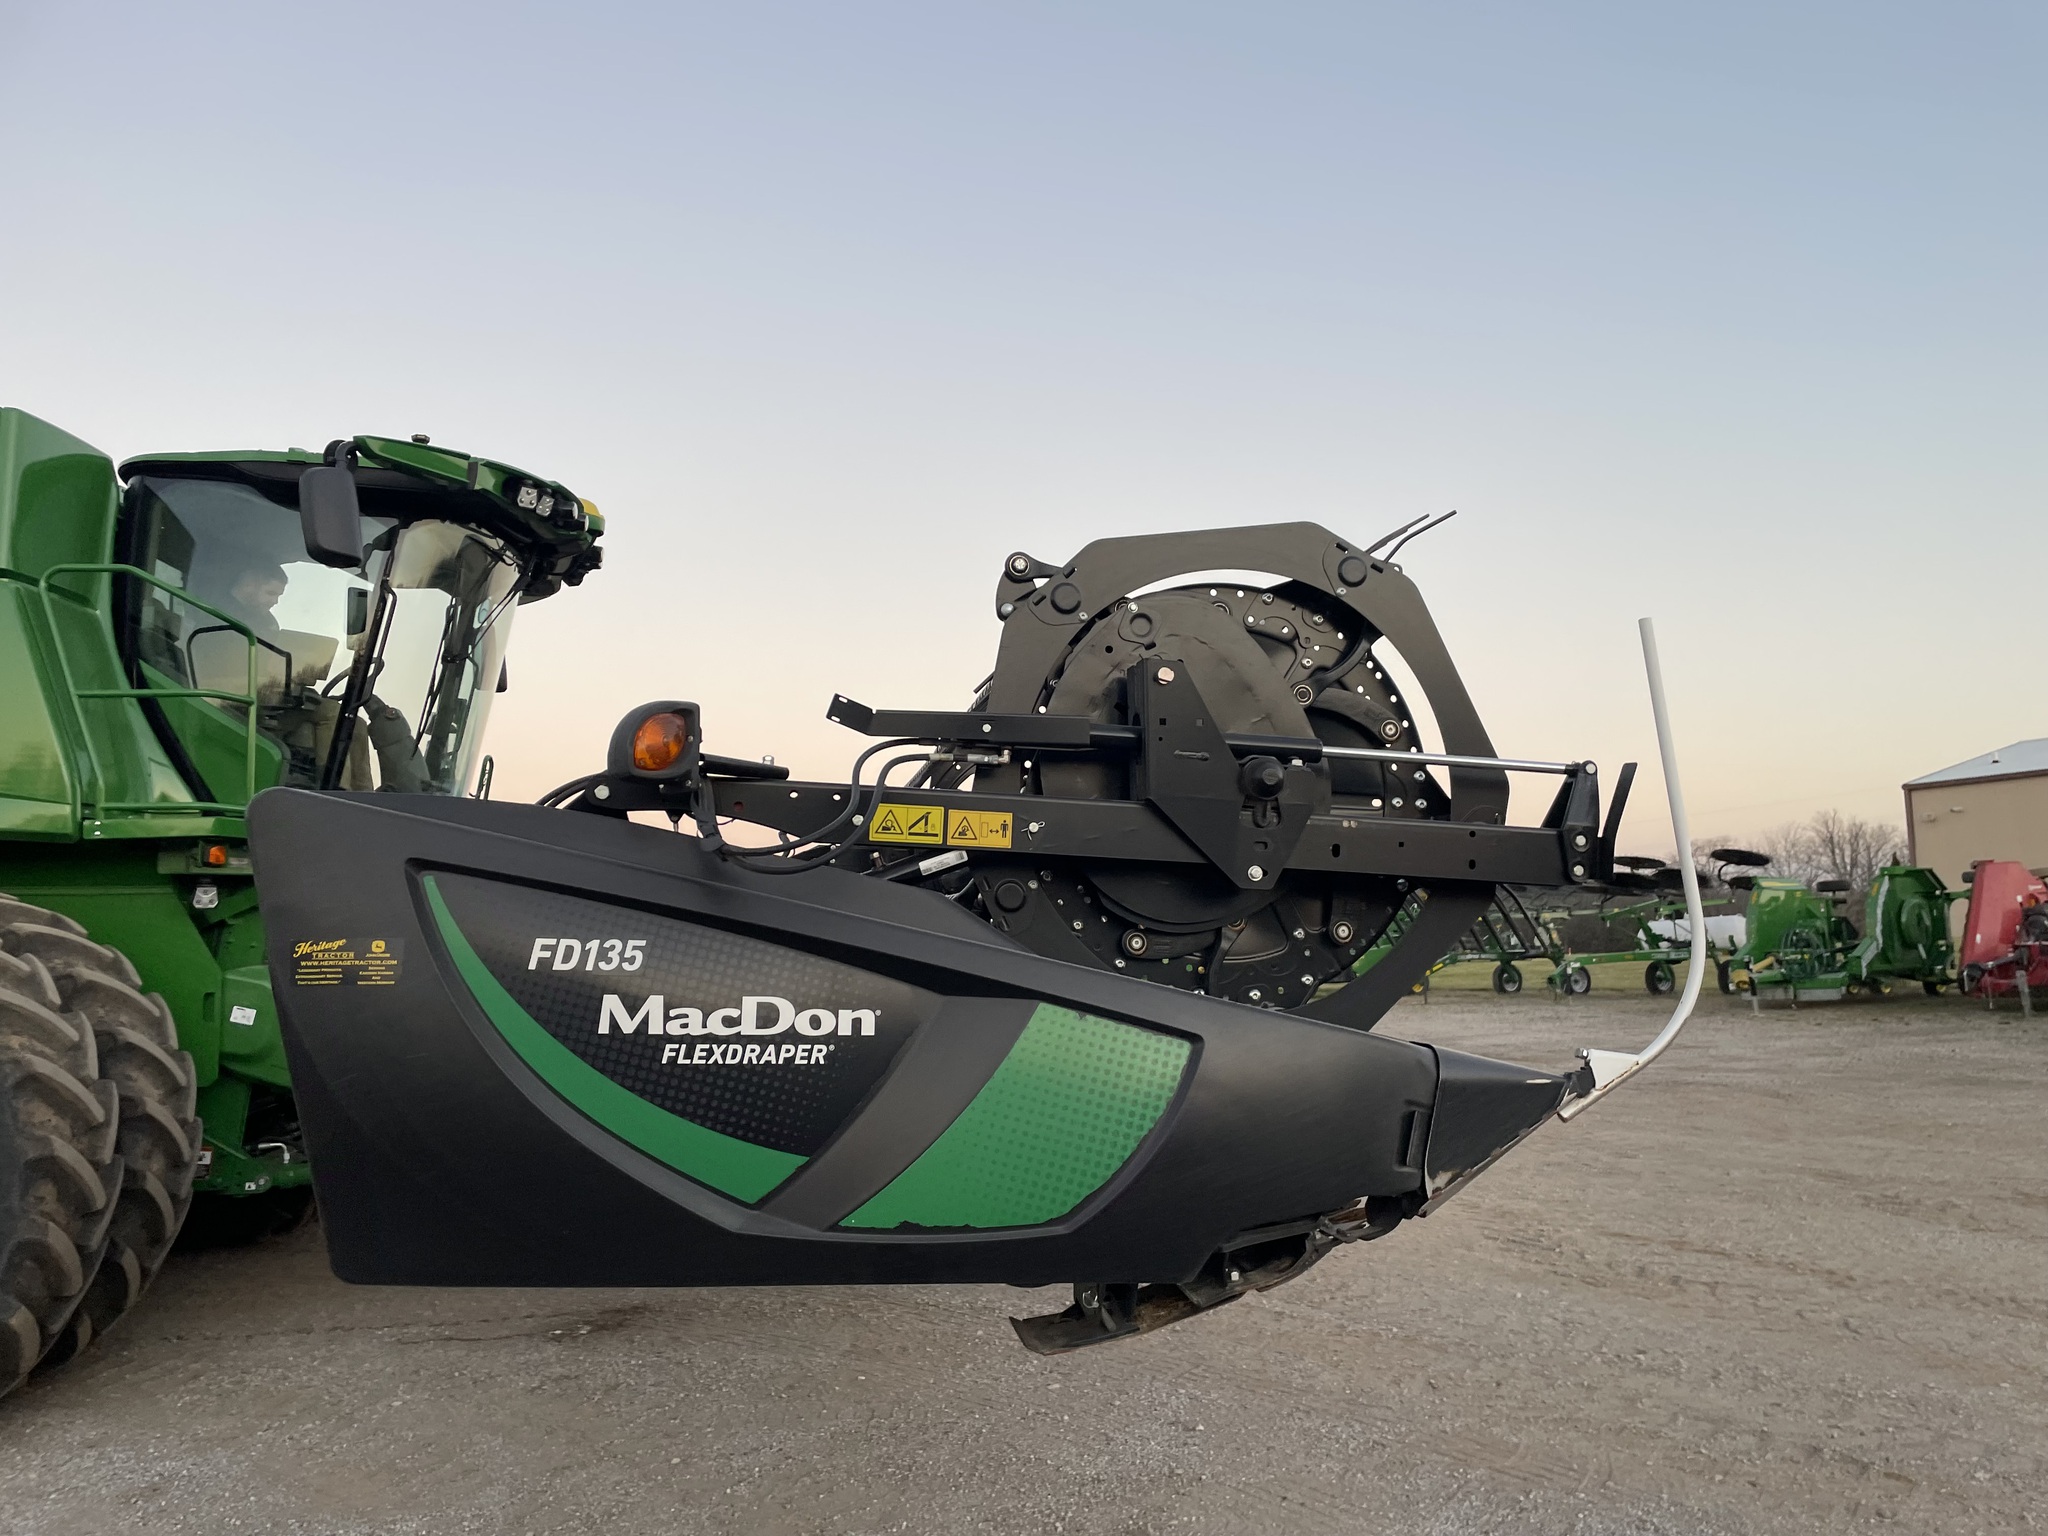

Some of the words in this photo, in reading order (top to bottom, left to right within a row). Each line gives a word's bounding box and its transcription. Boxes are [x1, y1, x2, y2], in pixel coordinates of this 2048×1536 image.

[293, 938, 347, 958] Heritage
[312, 952, 355, 960] TRACTOR
[527, 937, 647, 972] FD135
[597, 994, 876, 1037] MacDon
[661, 1043, 826, 1066] FLEXDRAPER
